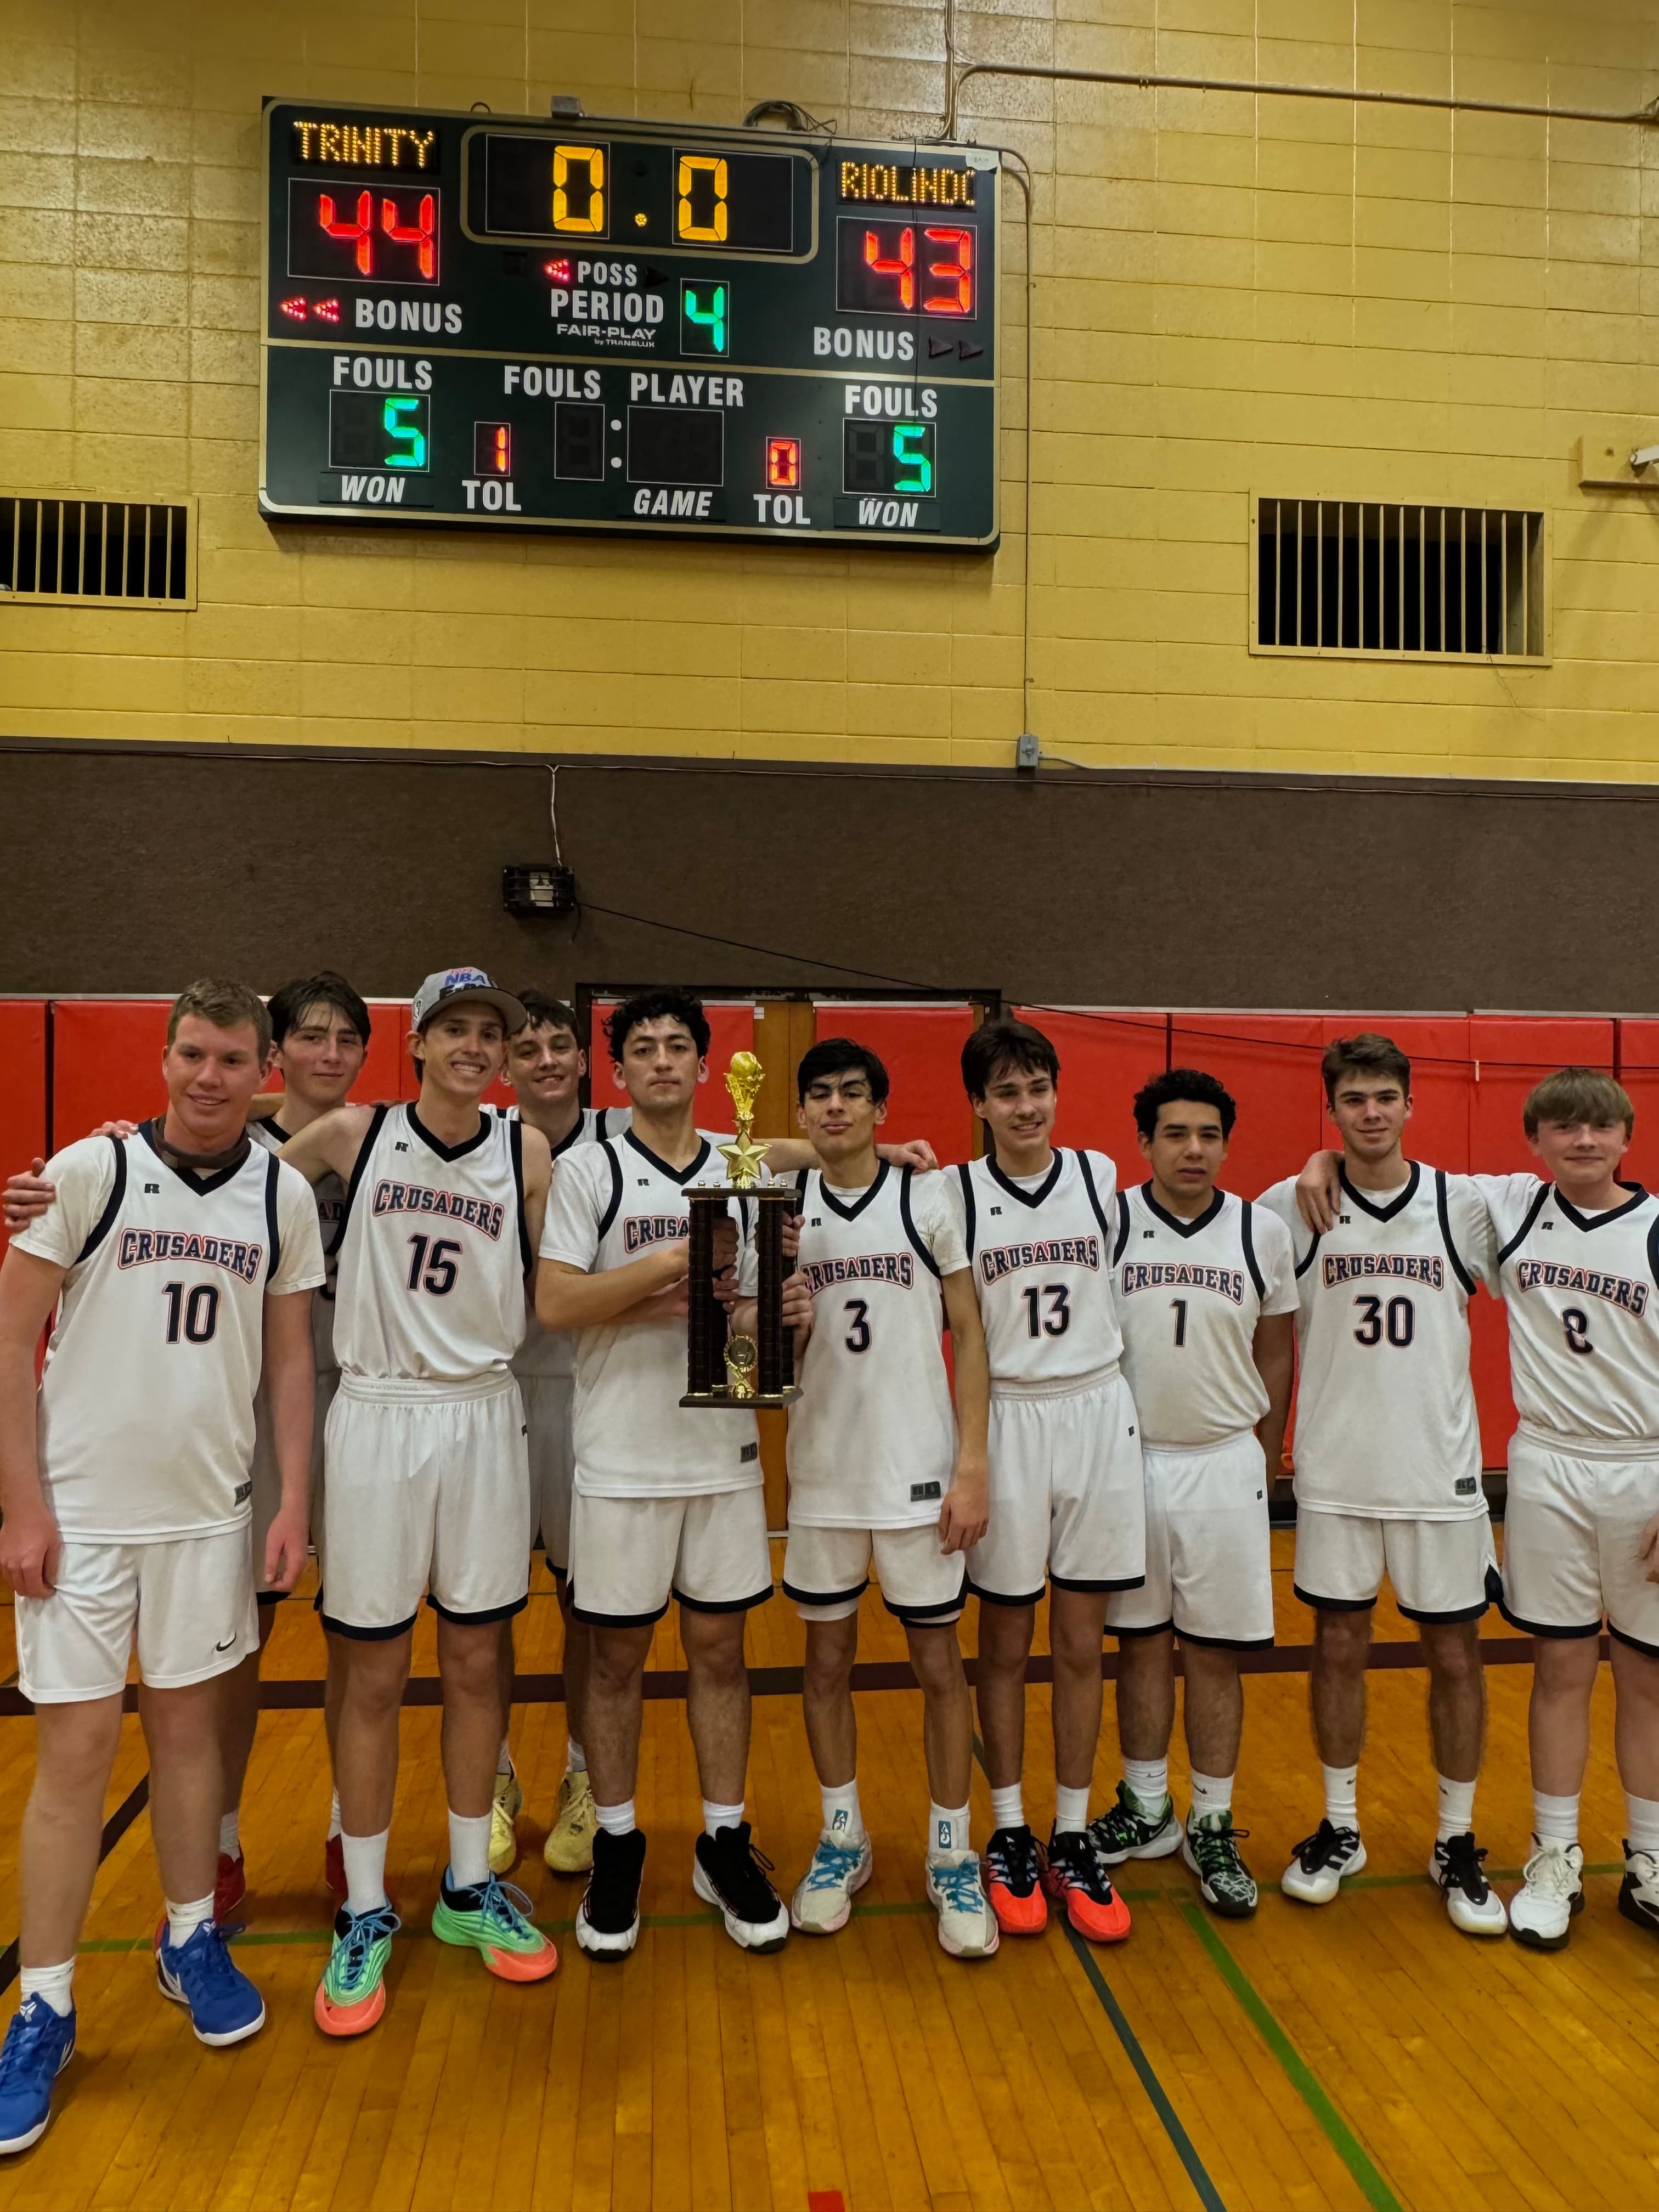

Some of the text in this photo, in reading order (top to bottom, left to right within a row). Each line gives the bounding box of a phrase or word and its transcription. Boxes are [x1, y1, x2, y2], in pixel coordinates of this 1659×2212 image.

[294, 121, 434, 168] TRINITY
[319, 190, 435, 279] 44
[578, 261, 637, 286] POSS
[865, 227, 972, 313] 43
[356, 298, 462, 334] BONUS
[551, 289, 664, 323] PERIOD
[685, 286, 724, 352] 4
[557, 324, 656, 340] FAIR-PLAY
[814, 327, 914, 360] BONUS
[333, 356, 432, 390] FOULS
[504, 365, 601, 399] FOULS
[630, 373, 744, 407] PLAYER
[845, 385, 938, 418] FOULS
[385, 397, 425, 467] 5
[495, 426, 508, 472] 1
[769, 440, 797, 486] 0
[893, 425, 932, 492] 5
[341, 475, 406, 503] WON
[461, 479, 522, 511] TOL
[633, 489, 713, 517] GAME
[753, 494, 811, 525] TOL
[858, 500, 918, 527] WON
[445, 972, 486, 986] NBA
[373, 1180, 505, 1241] CRUSADERS
[118, 1228, 262, 1284] CRUSADERS
[624, 1216, 690, 1254] CRUSA
[407, 1233, 462, 1296] 15
[980, 1236, 1099, 1285] CRUSADERS
[1323, 1254, 1444, 1291] CRUSADERS
[1121, 1263, 1244, 1305] CRUSADERS
[1517, 1259, 1649, 1317] CRUSADERS
[162, 1282, 219, 1344] 10
[843, 1299, 872, 1354] 3
[1021, 1282, 1071, 1339] 13
[1169, 1298, 1189, 1348] 1
[1352, 1294, 1415, 1348] 30
